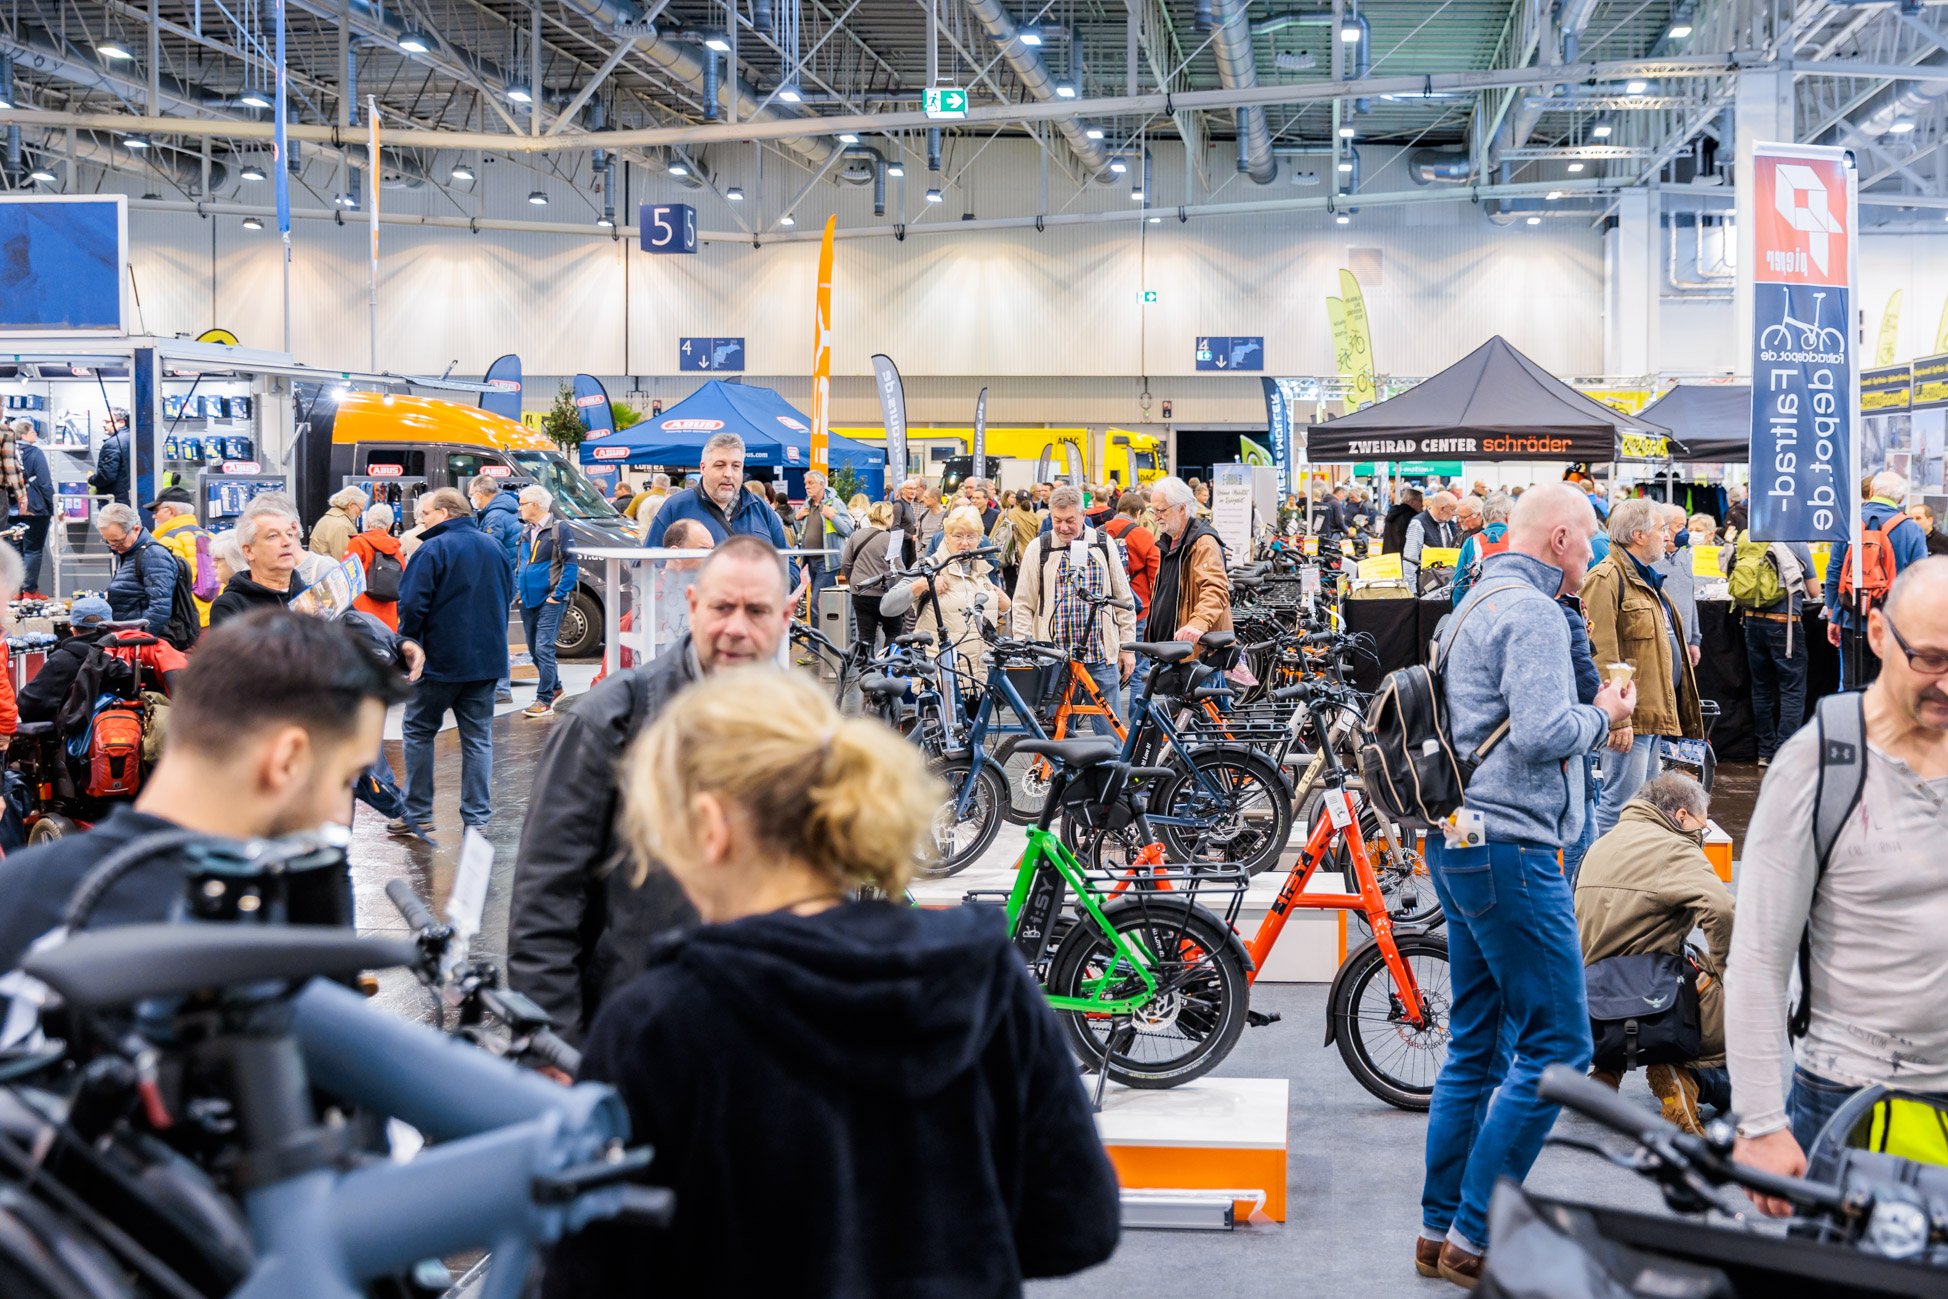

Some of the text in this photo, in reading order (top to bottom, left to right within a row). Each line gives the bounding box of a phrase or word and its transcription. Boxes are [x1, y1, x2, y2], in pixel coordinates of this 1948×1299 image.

[651, 207, 673, 246] 5
[686, 209, 696, 248] 5
[681, 339, 692, 356] 4
[1198, 338, 1210, 351] 4
[672, 420, 715, 429] ABUS
[1348, 433, 1573, 454] ZWEIRAD CENTER schröder
[599, 448, 625, 458] ABUS
[744, 451, 769, 459] us.com
[229, 463, 257, 473] ABUS
[373, 466, 399, 474] ABUS
[1029, 876, 1055, 924] i:SY
